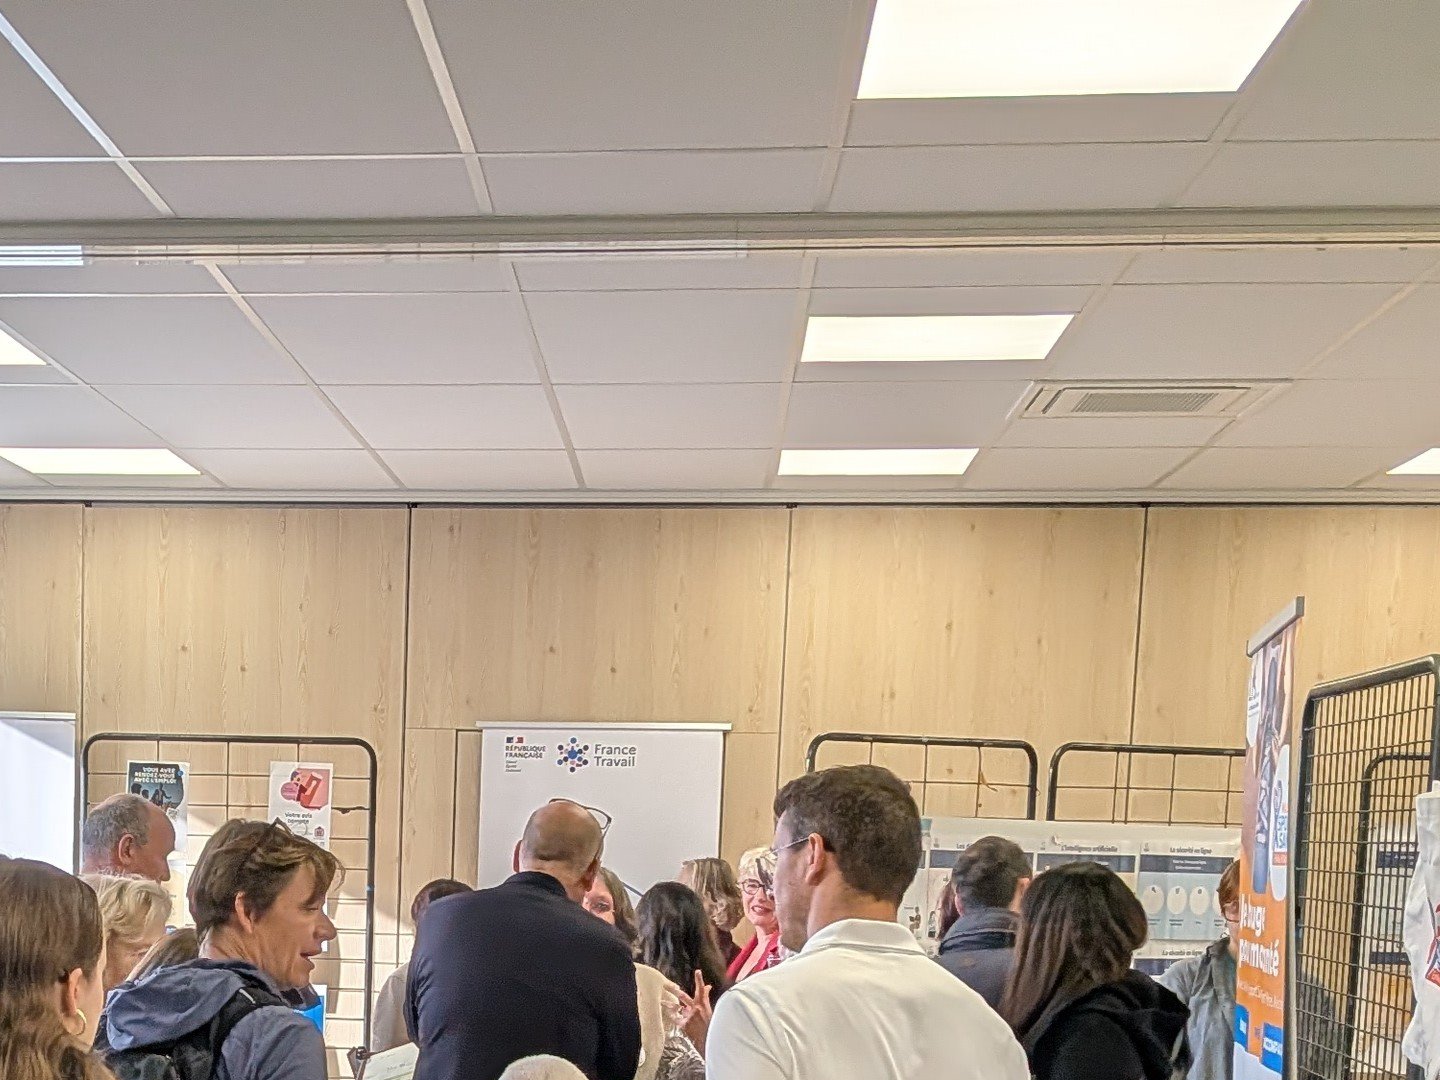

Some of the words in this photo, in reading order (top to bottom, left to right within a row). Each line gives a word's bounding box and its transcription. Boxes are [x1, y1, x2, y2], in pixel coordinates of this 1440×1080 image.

[505, 745, 546, 753] RÉPUBLIQUE
[594, 744, 637, 755] France
[594, 756, 635, 767] Travail
